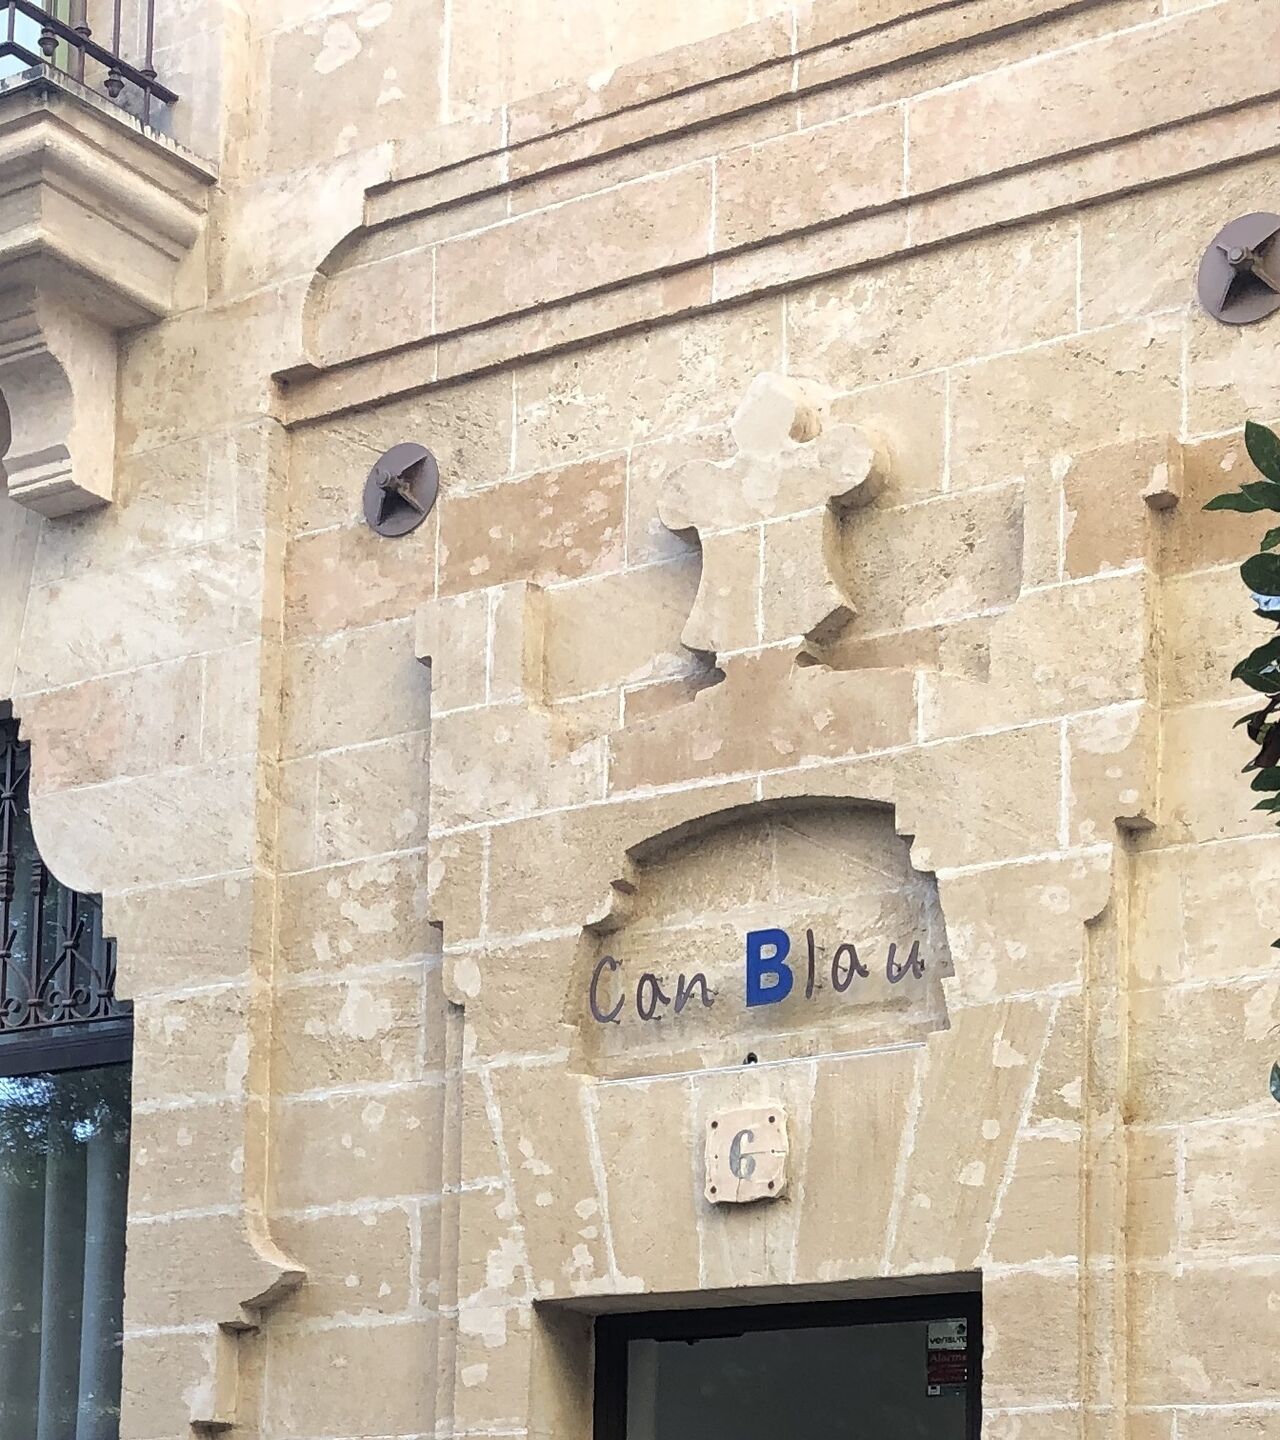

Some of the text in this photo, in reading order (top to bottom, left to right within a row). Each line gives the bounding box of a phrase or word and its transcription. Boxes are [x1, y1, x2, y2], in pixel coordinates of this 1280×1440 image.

[588, 927, 924, 1024] Can Blau
[728, 1128, 758, 1180] 6
